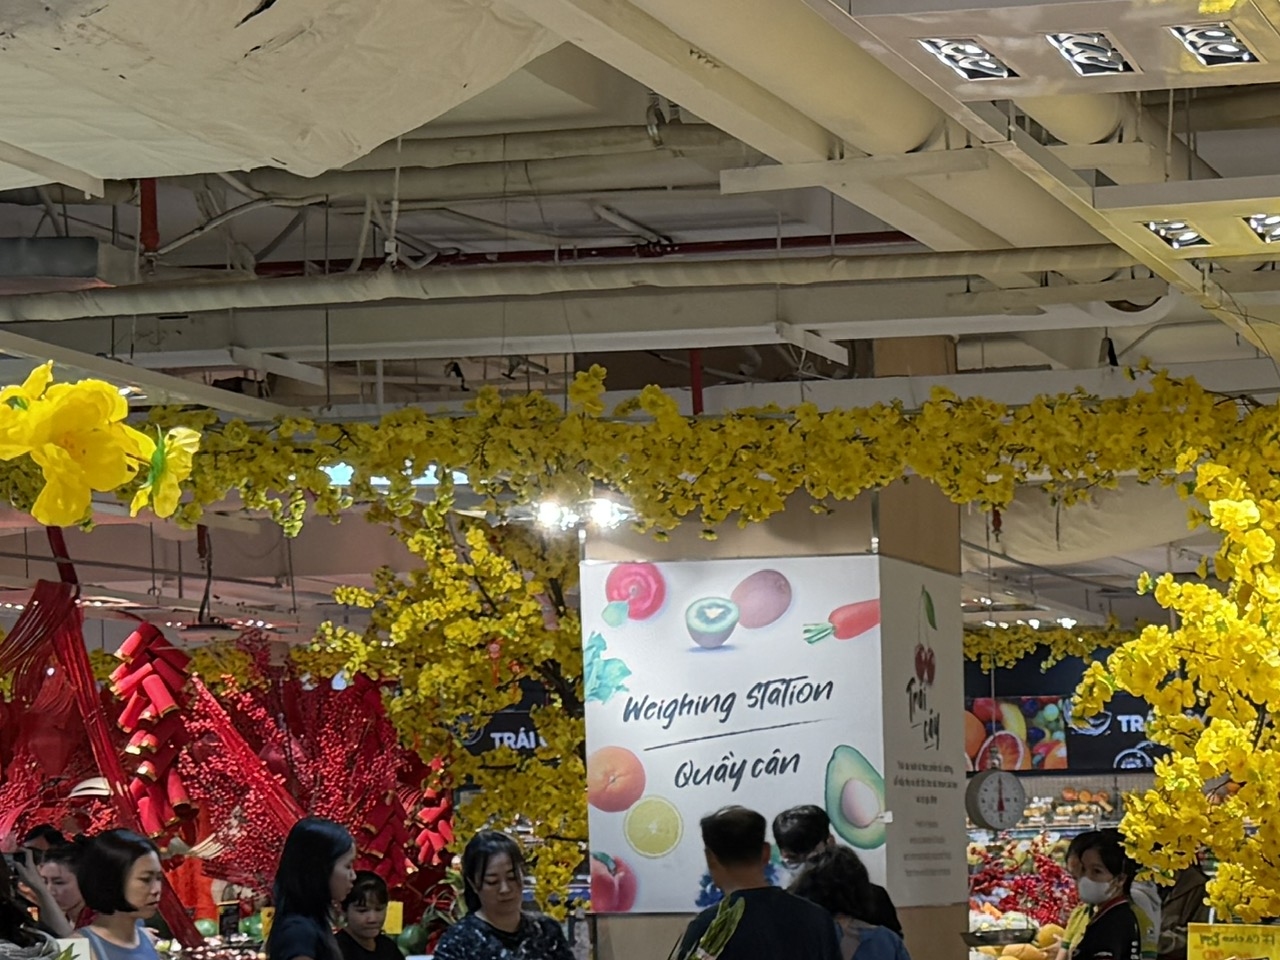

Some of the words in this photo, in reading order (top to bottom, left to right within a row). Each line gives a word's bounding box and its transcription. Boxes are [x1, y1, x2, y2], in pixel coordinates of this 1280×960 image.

[622, 689, 736, 730] Weighing
[747, 675, 834, 711] Station
[490, 726, 536, 750] TRÁI
[674, 749, 745, 792] Quầy
[751, 748, 801, 779] cân
